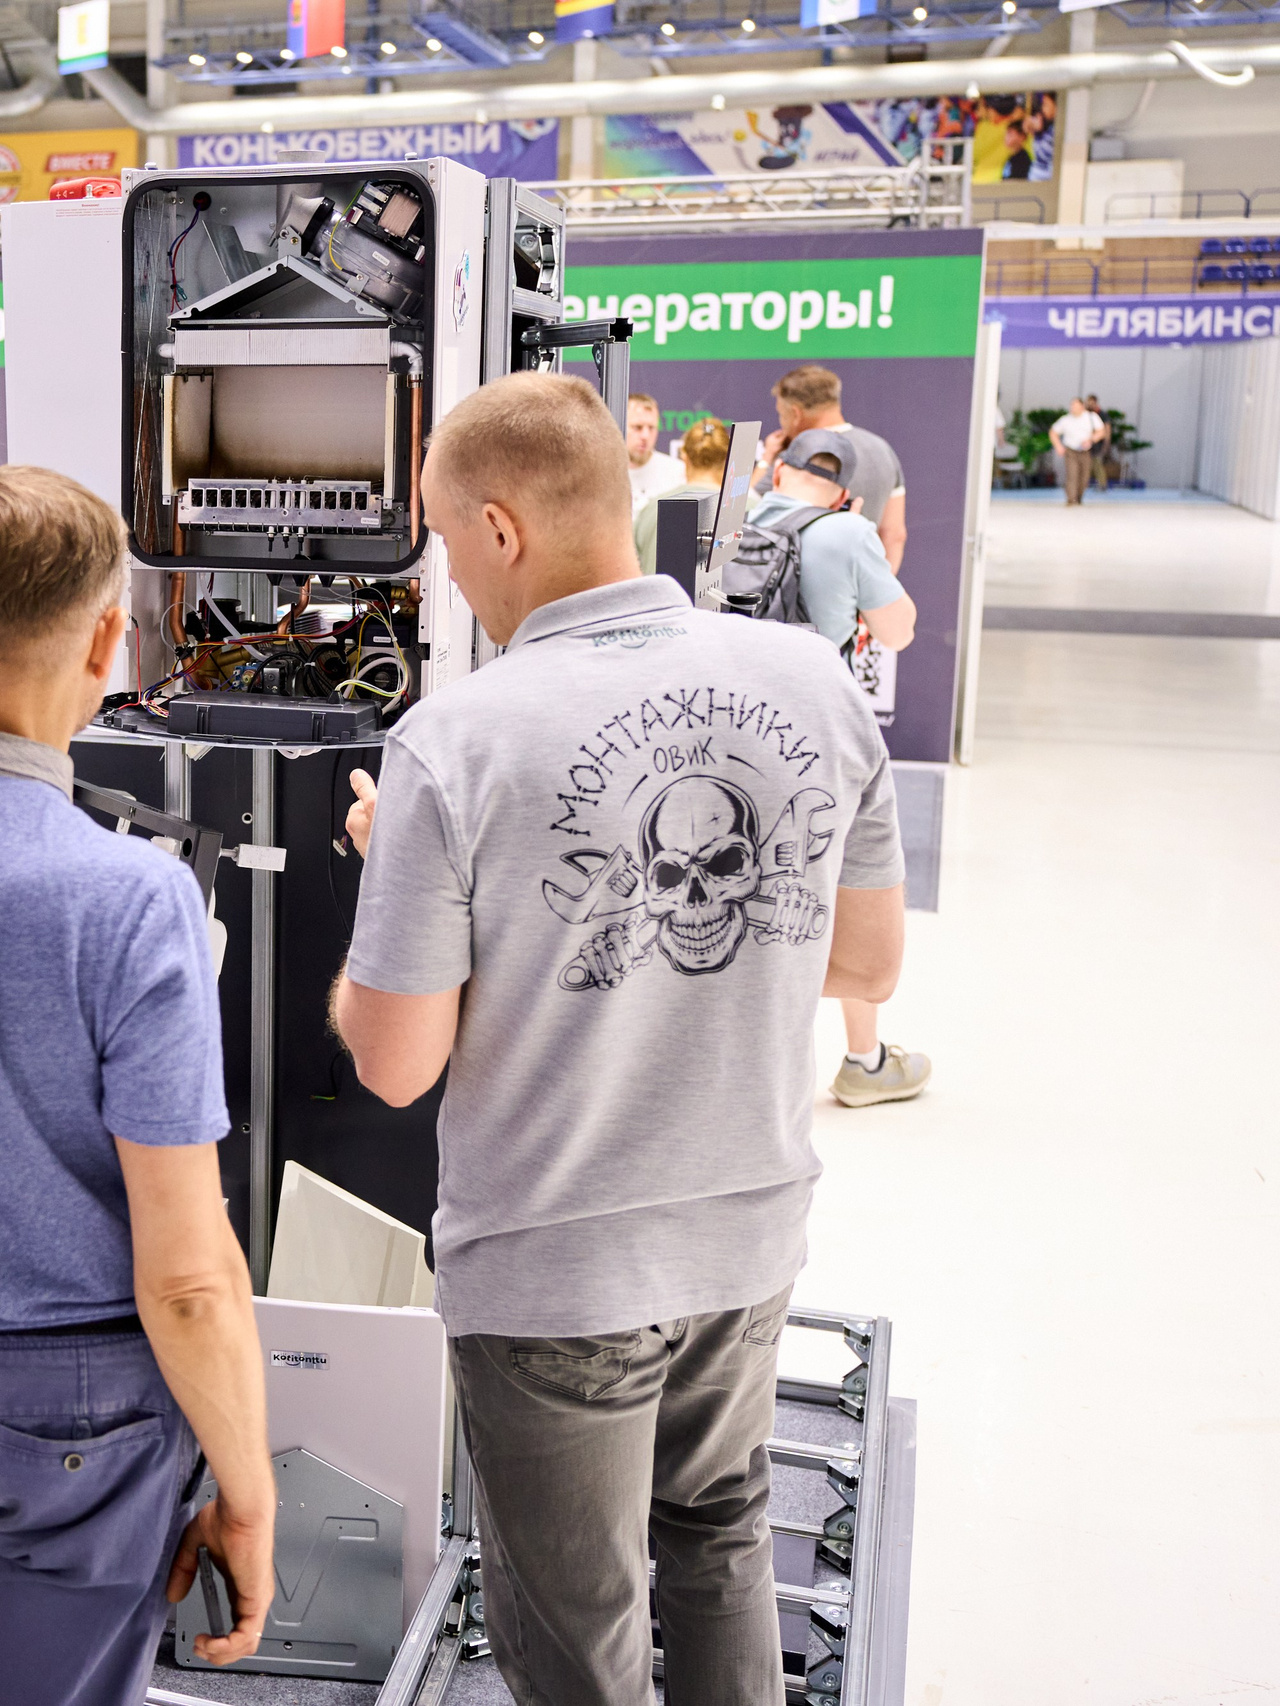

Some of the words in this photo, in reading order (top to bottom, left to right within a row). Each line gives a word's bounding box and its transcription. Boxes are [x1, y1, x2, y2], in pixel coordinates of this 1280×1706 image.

[48, 153, 111, 171] ВМЕСТЕ
[193, 123, 501, 166] КОНЬКОБЕЖНЫЙ
[1048, 305, 1280, 338] ЧЕЛЯБИНС
[550, 687, 820, 836] МОНТАЖНИКИ
